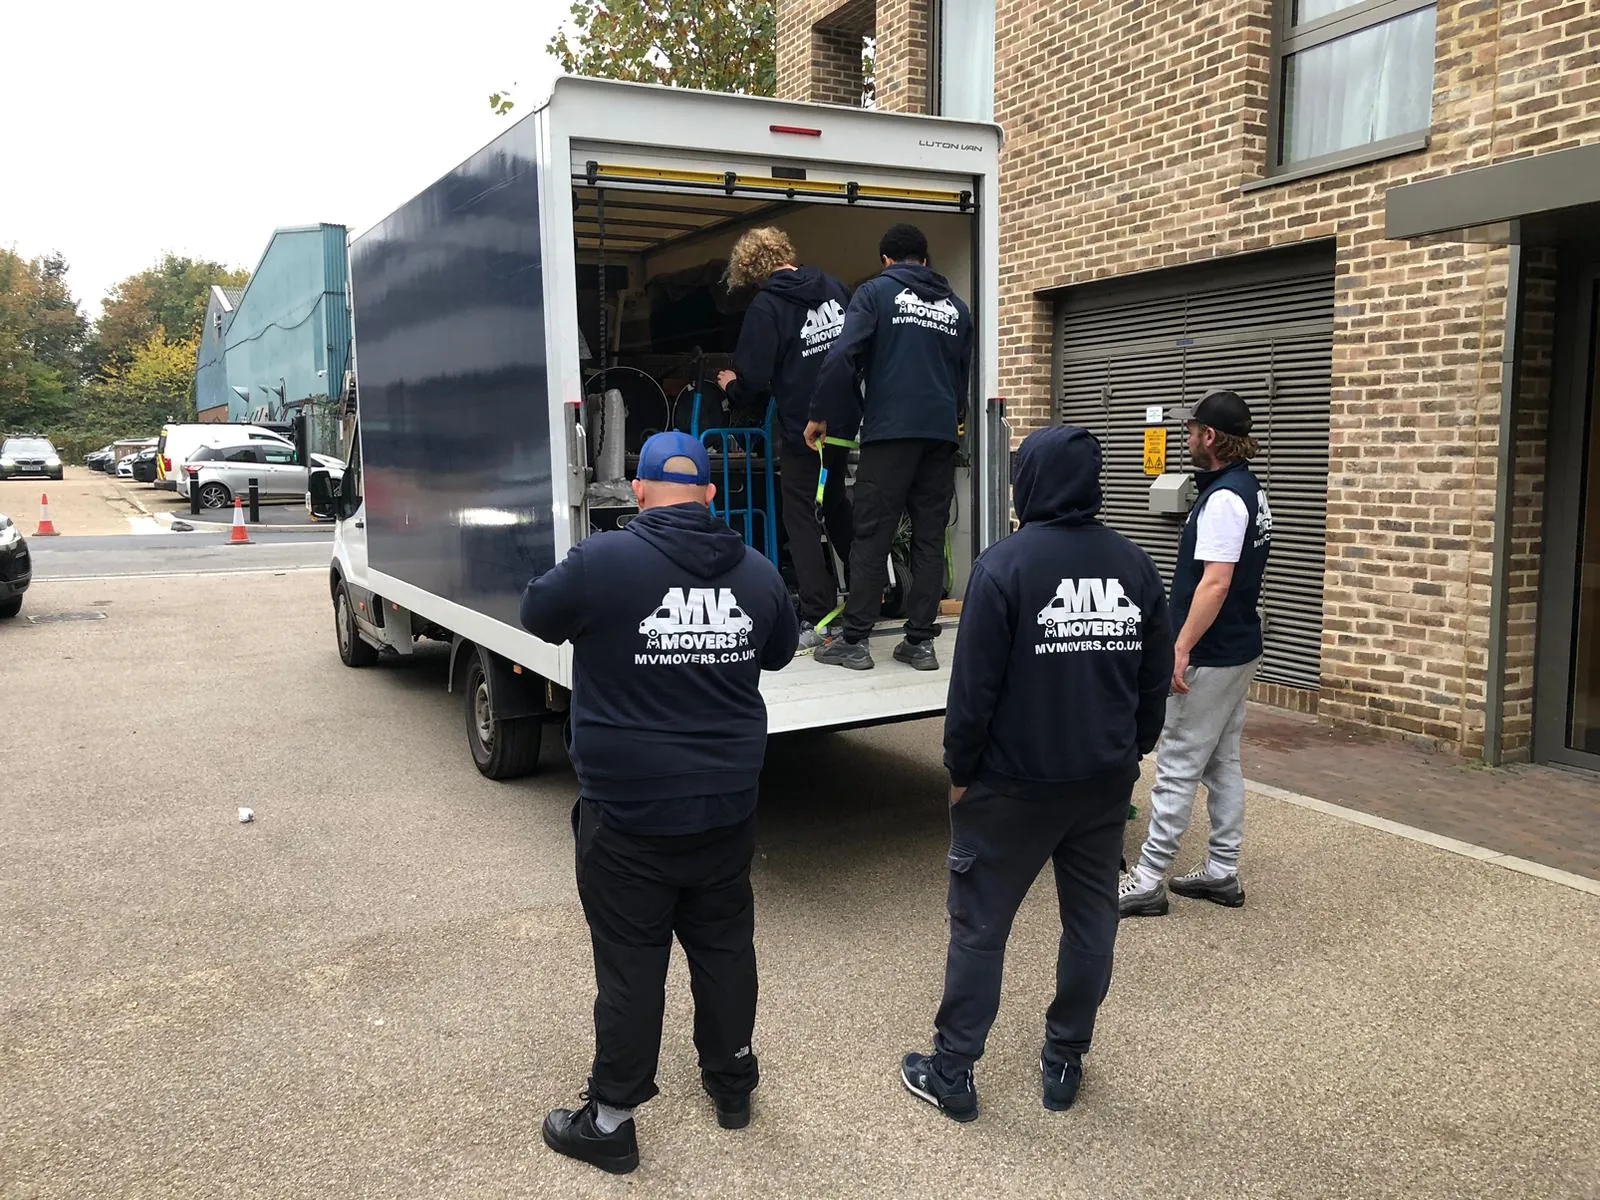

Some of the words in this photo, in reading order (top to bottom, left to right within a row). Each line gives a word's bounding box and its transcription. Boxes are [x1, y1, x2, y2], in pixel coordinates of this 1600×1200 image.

[918, 140, 959, 150] LUTON
[960, 144, 983, 152] VAN
[907, 303, 950, 324] MOVERS
[811, 324, 844, 345] MOVER
[892, 315, 959, 337] MVMOVERS.CO.U
[1060, 578, 1120, 613] MV
[668, 587, 732, 625] MV
[1057, 620, 1125, 638] MOVERS
[660, 633, 737, 650] MOVERS
[1034, 640, 1143, 655] MVMOVERS.CO.UK
[634, 649, 757, 665] MVMOVERS.CO.UK
